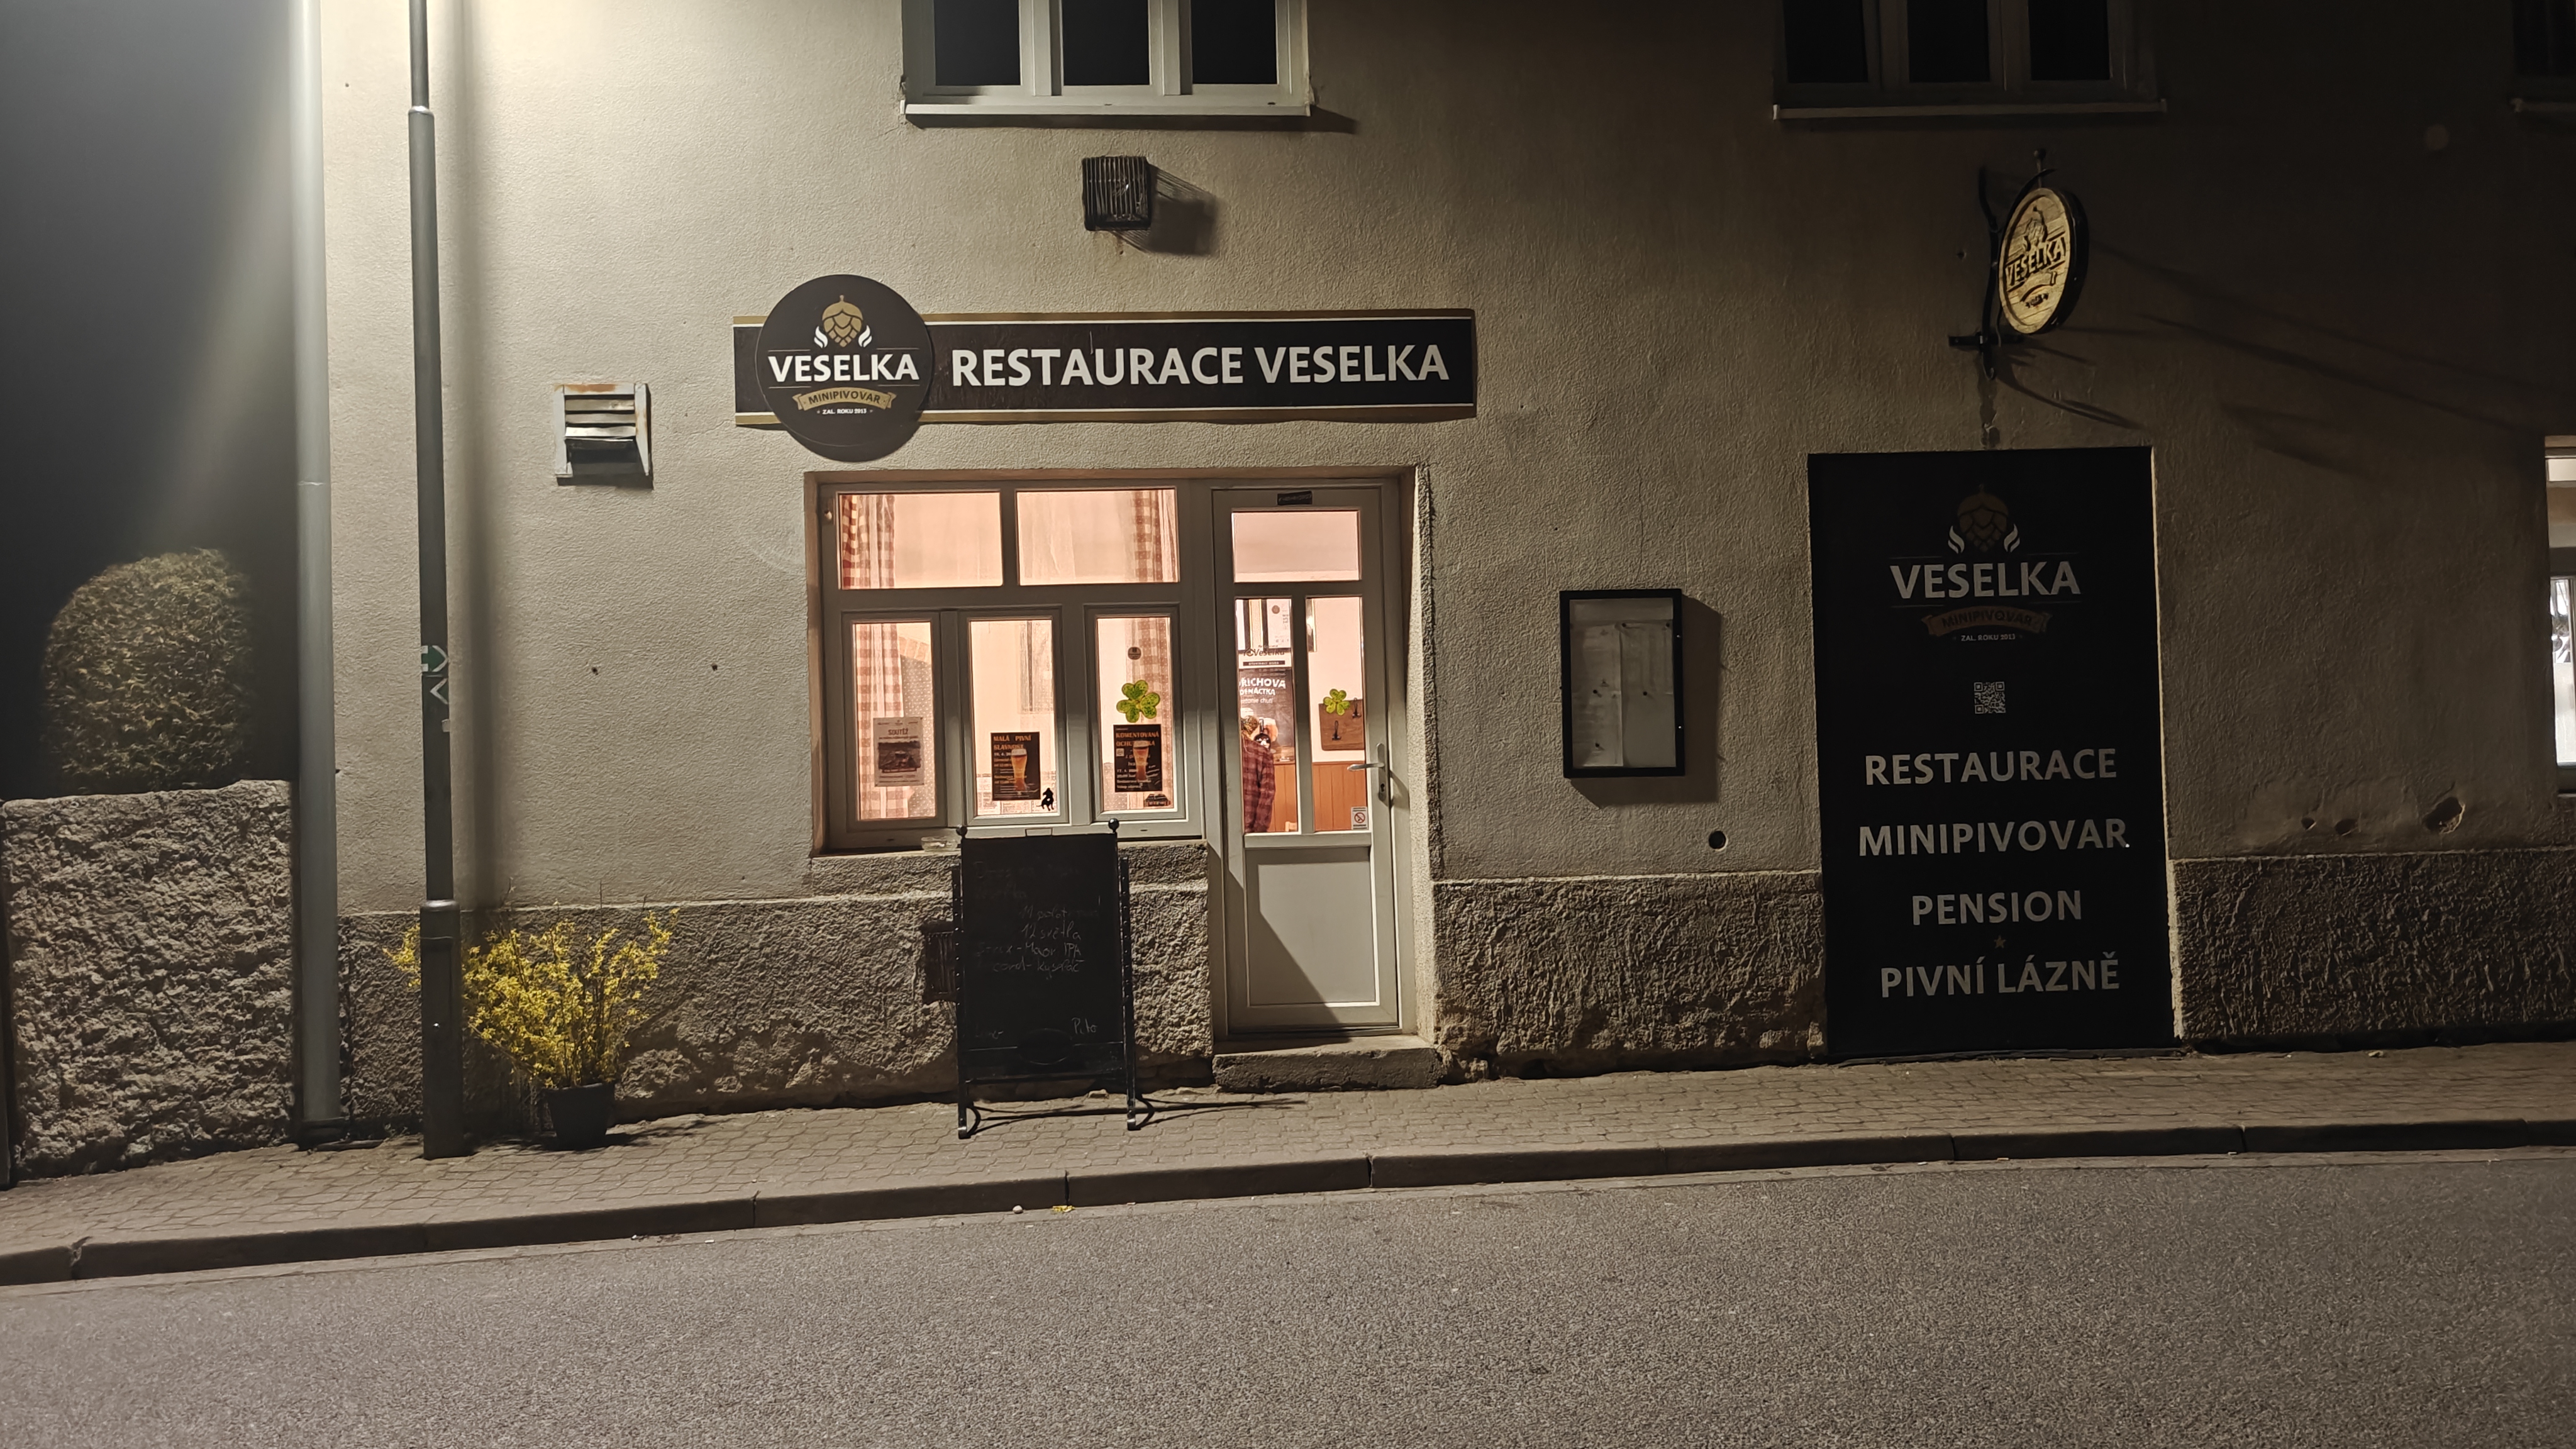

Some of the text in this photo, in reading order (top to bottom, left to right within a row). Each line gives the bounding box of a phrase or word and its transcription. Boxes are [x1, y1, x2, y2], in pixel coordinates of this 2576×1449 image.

[2006, 237, 2067, 286] VESELKA
[768, 353, 919, 382] VESELKA
[952, 344, 1450, 387] RESTAURACE VESELKA
[808, 390, 881, 405] MINIPIVOVAR
[1889, 560, 2082, 599] VESELKA
[1941, 609, 2033, 628] MINIPIVOVAR
[1865, 748, 2117, 786] RESTAURACE
[1859, 818, 2127, 857] MINIPIVOVAR
[1913, 890, 2082, 926] PENSION
[1063, 941, 1082, 958] IPA
[1881, 951, 2120, 998] PIVNÍ LÁZNĚ
